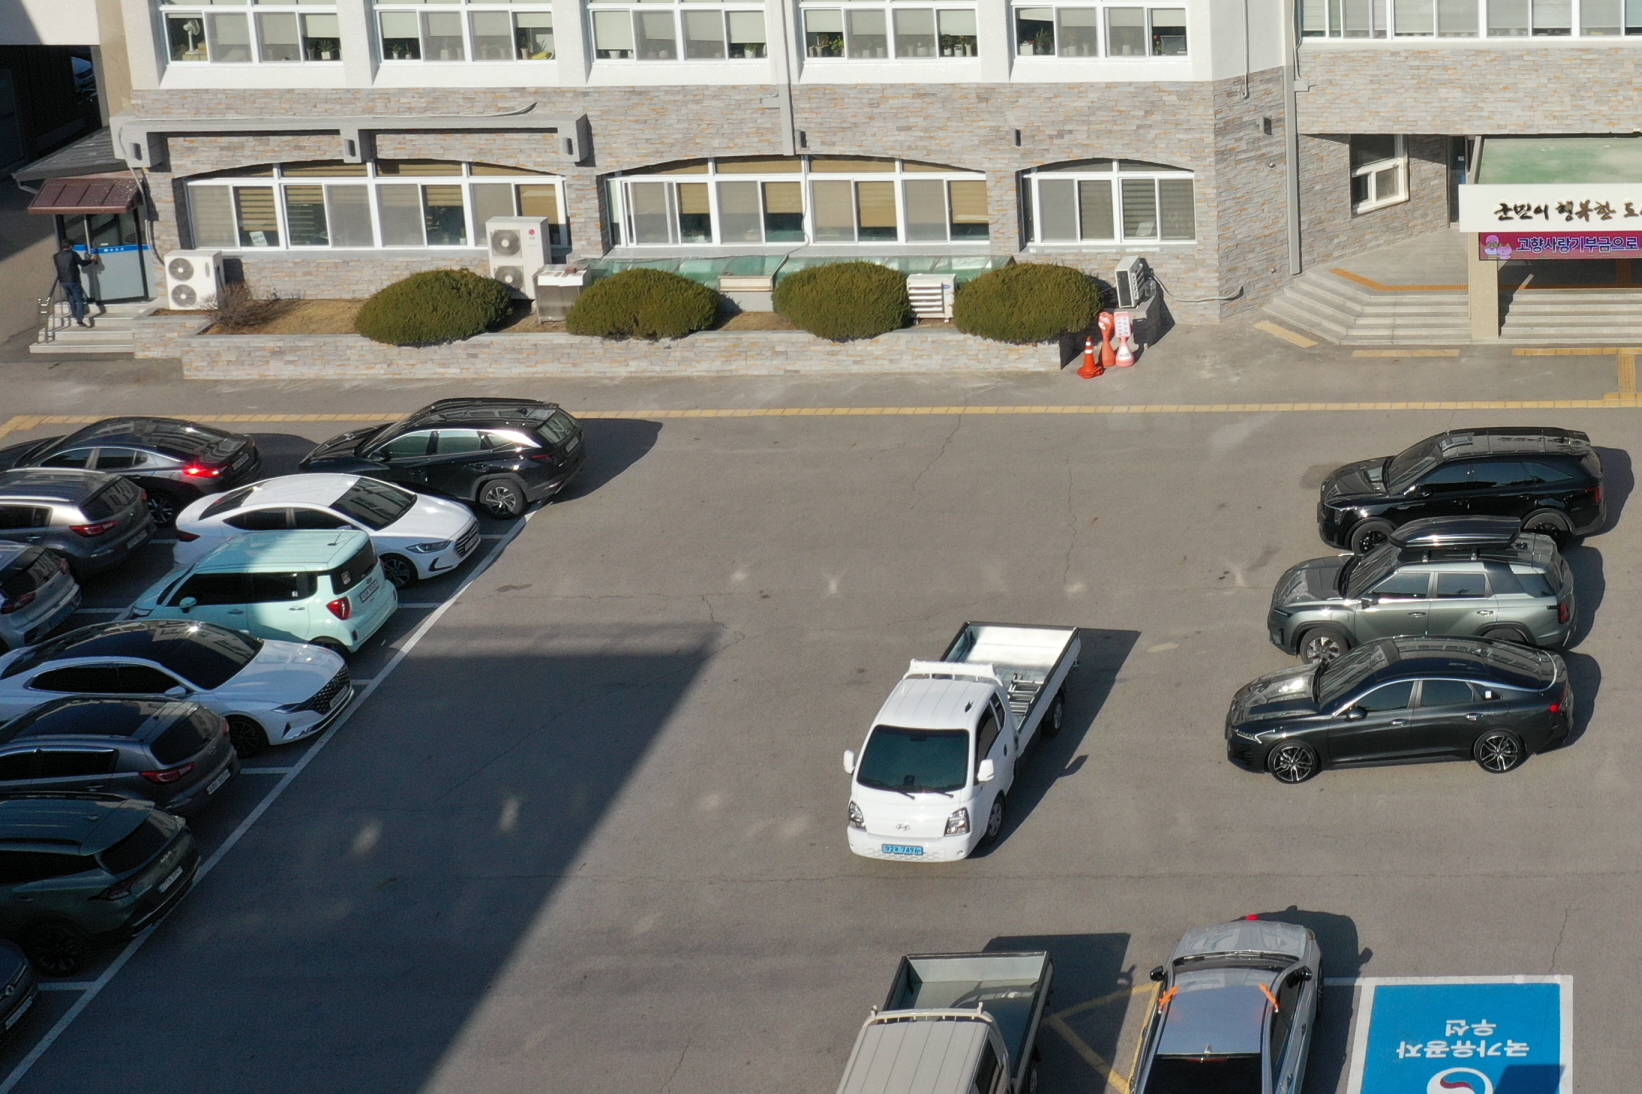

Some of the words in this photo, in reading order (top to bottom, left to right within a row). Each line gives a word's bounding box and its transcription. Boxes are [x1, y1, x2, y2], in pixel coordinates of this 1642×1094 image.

[1494, 202, 1549, 222] 군민이
[1555, 199, 1617, 222] 행복한
[1516, 236, 1640, 254] 고향사랑기부금으로
[1445, 1019, 1497, 1037] 우선
[1396, 1039, 1530, 1059] 국가유공자
